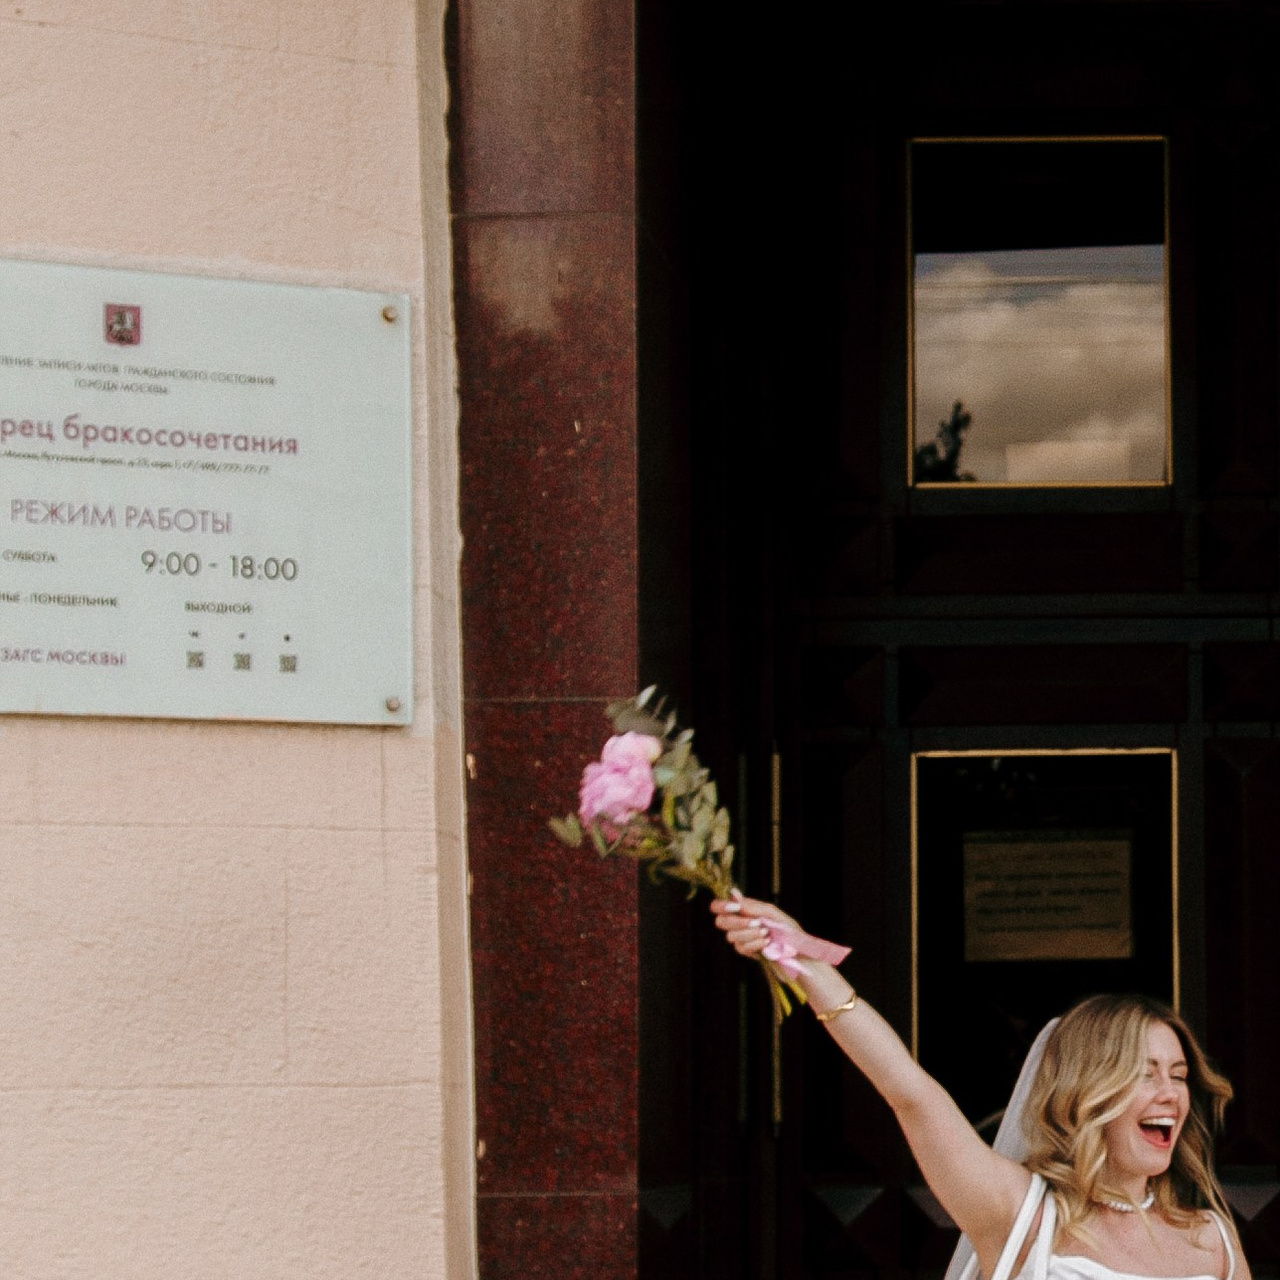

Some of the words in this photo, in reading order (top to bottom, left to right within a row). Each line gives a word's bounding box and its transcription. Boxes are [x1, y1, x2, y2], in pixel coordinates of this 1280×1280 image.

[210, 372, 275, 385] СОСТОЯНИЯ
[0, 418, 54, 444] рец
[63, 412, 298, 454] бракосочетания
[10, 499, 116, 527] РЕЖИМ
[125, 505, 232, 534] РАБОТЫ
[2, 549, 56, 563] СУББОТА
[141, 550, 200, 576] 9:00
[230, 555, 298, 581] 18:00
[30, 592, 118, 607] ПОНЕДЕЛЬНИК
[184, 601, 253, 615] ВЫХОДНОЙ
[0, 647, 42, 664] ЗАГС
[46, 648, 126, 666] МОСКВЫ
